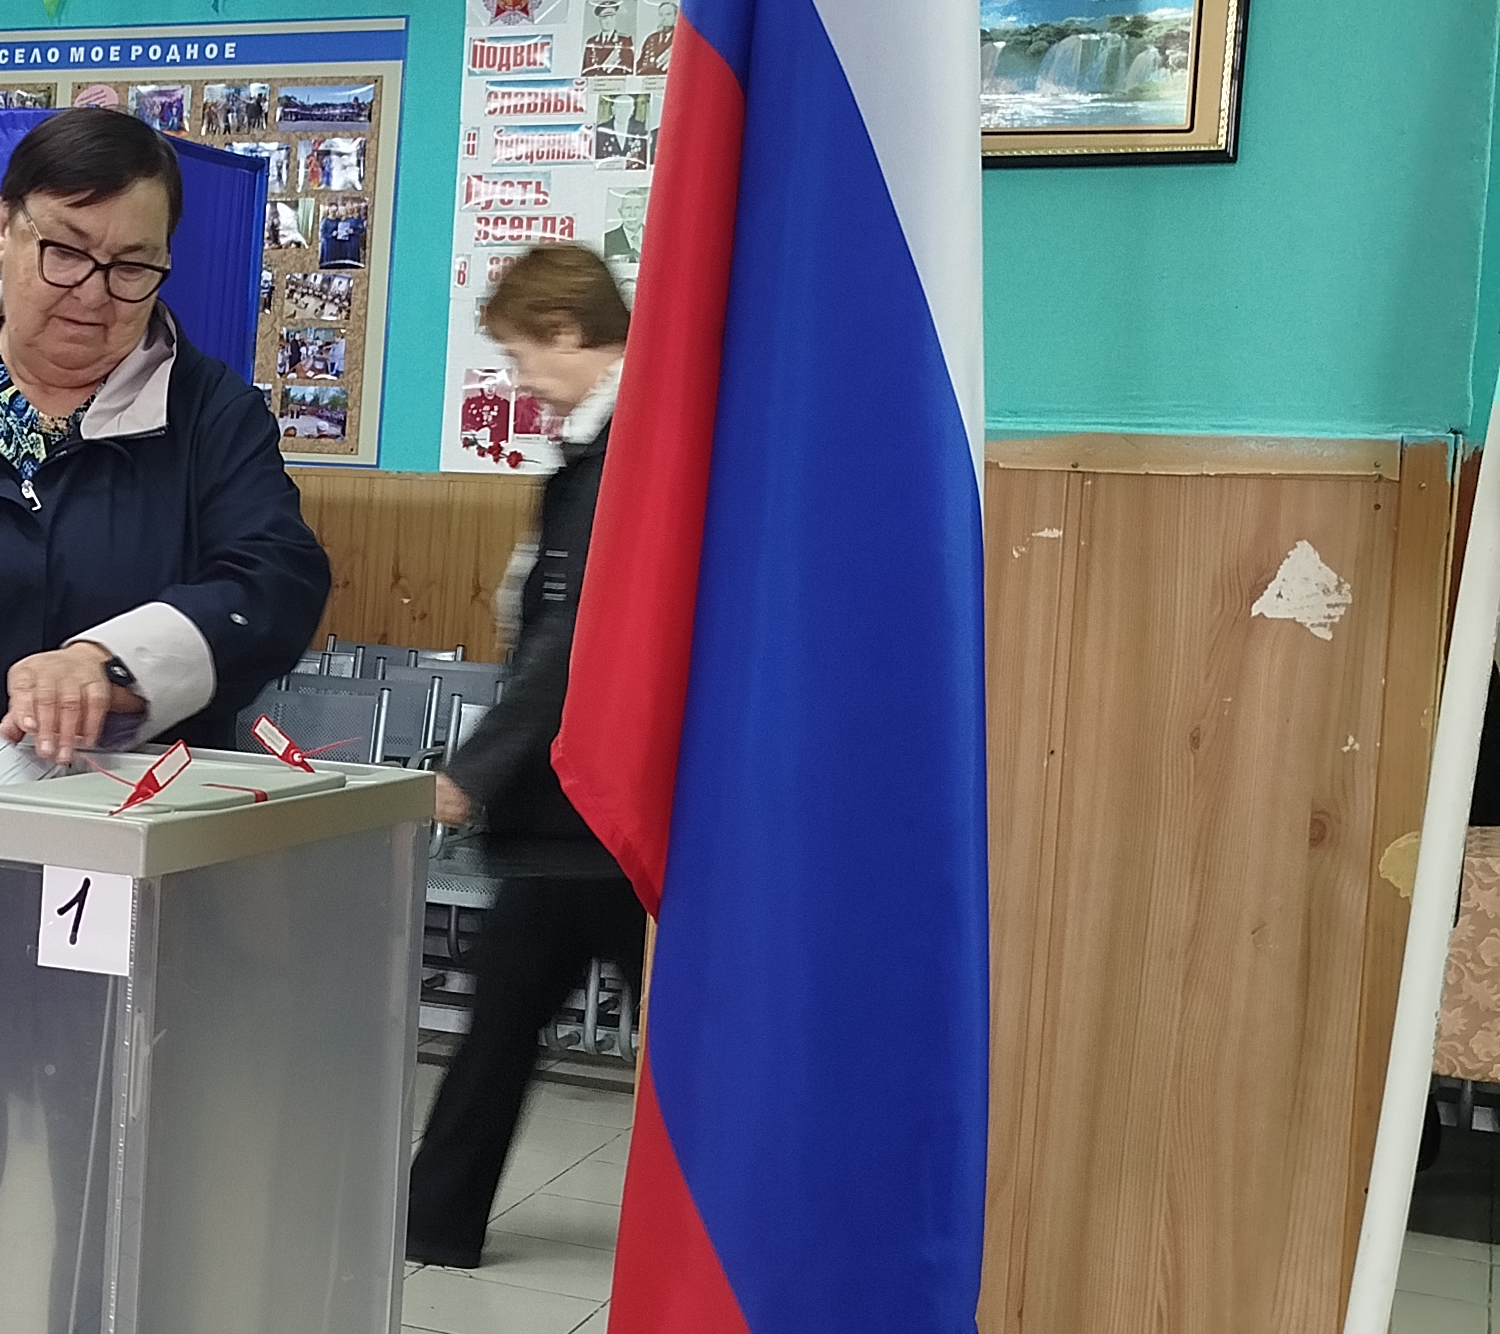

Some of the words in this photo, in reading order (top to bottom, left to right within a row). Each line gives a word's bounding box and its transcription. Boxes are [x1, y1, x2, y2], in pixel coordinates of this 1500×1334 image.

[69, 45, 121, 63] МОЕ
[130, 42, 237, 63] РОДНОЕ
[471, 39, 551, 72] Подвиг
[486, 80, 585, 116] славный
[466, 132, 476, 156] и
[465, 174, 549, 211] Пусть
[474, 215, 575, 242] всегда
[56, 877, 91, 945] 1
